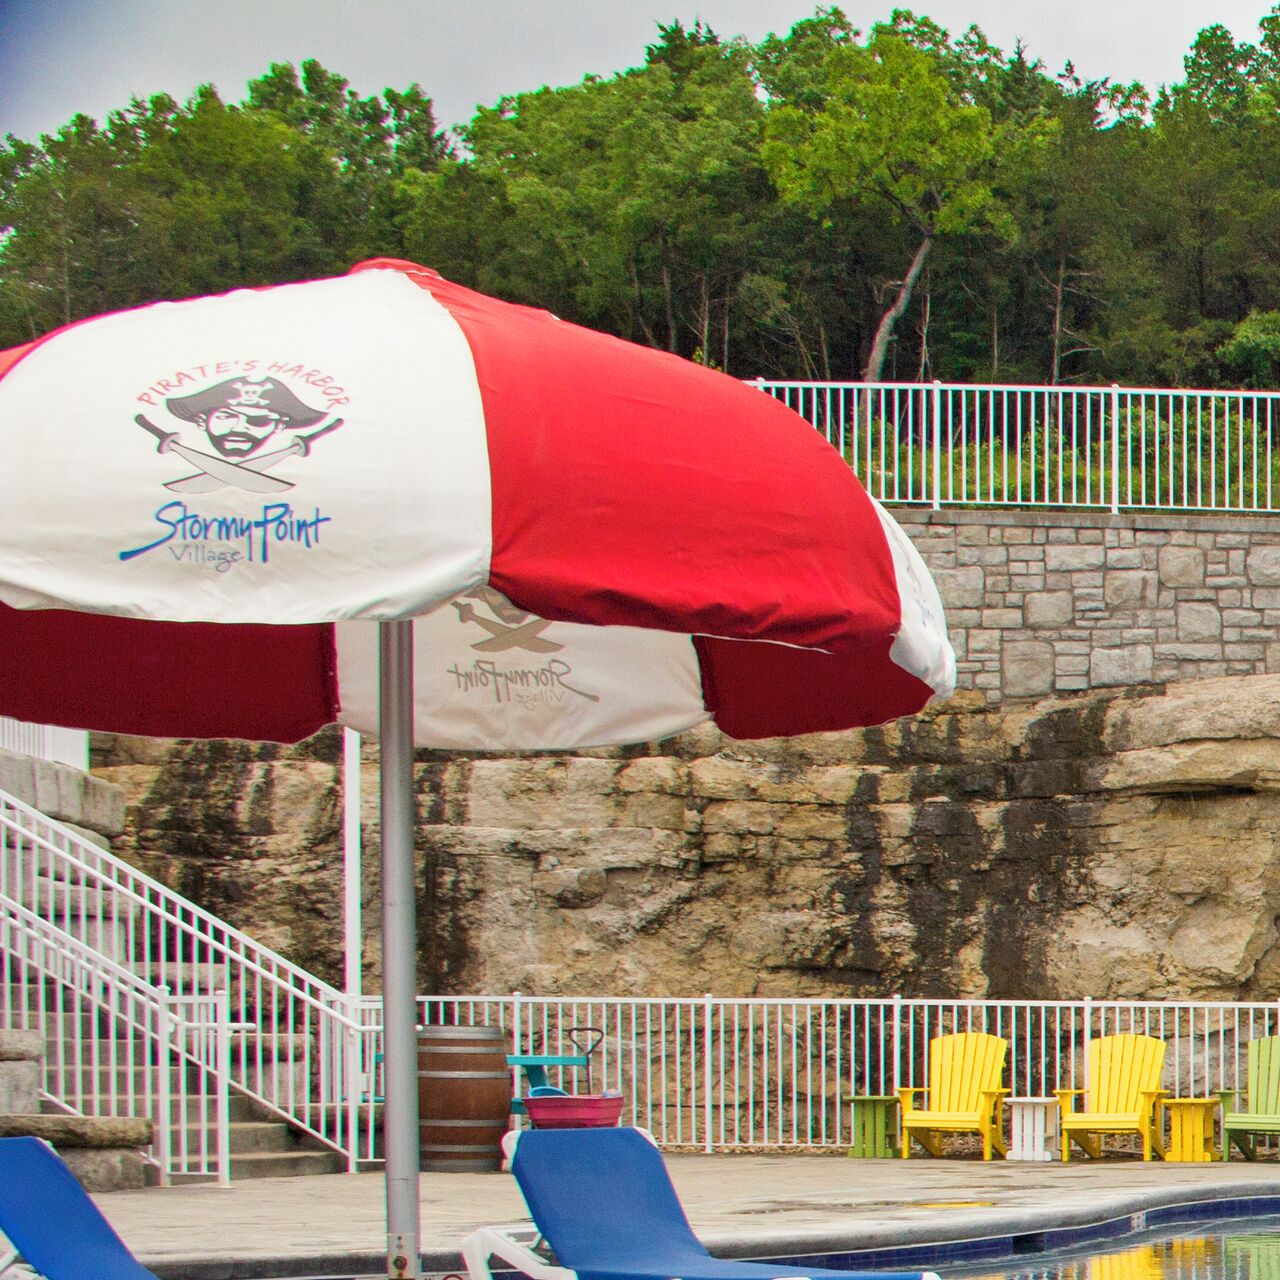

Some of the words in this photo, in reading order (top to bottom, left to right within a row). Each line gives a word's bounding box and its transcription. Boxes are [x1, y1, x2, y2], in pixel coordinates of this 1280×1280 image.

[136, 360, 260, 406] PIRATE'S
[267, 360, 351, 409] HARBOR
[119, 501, 254, 561] Stormy
[254, 503, 331, 563] Point
[169, 545, 245, 573] Village
